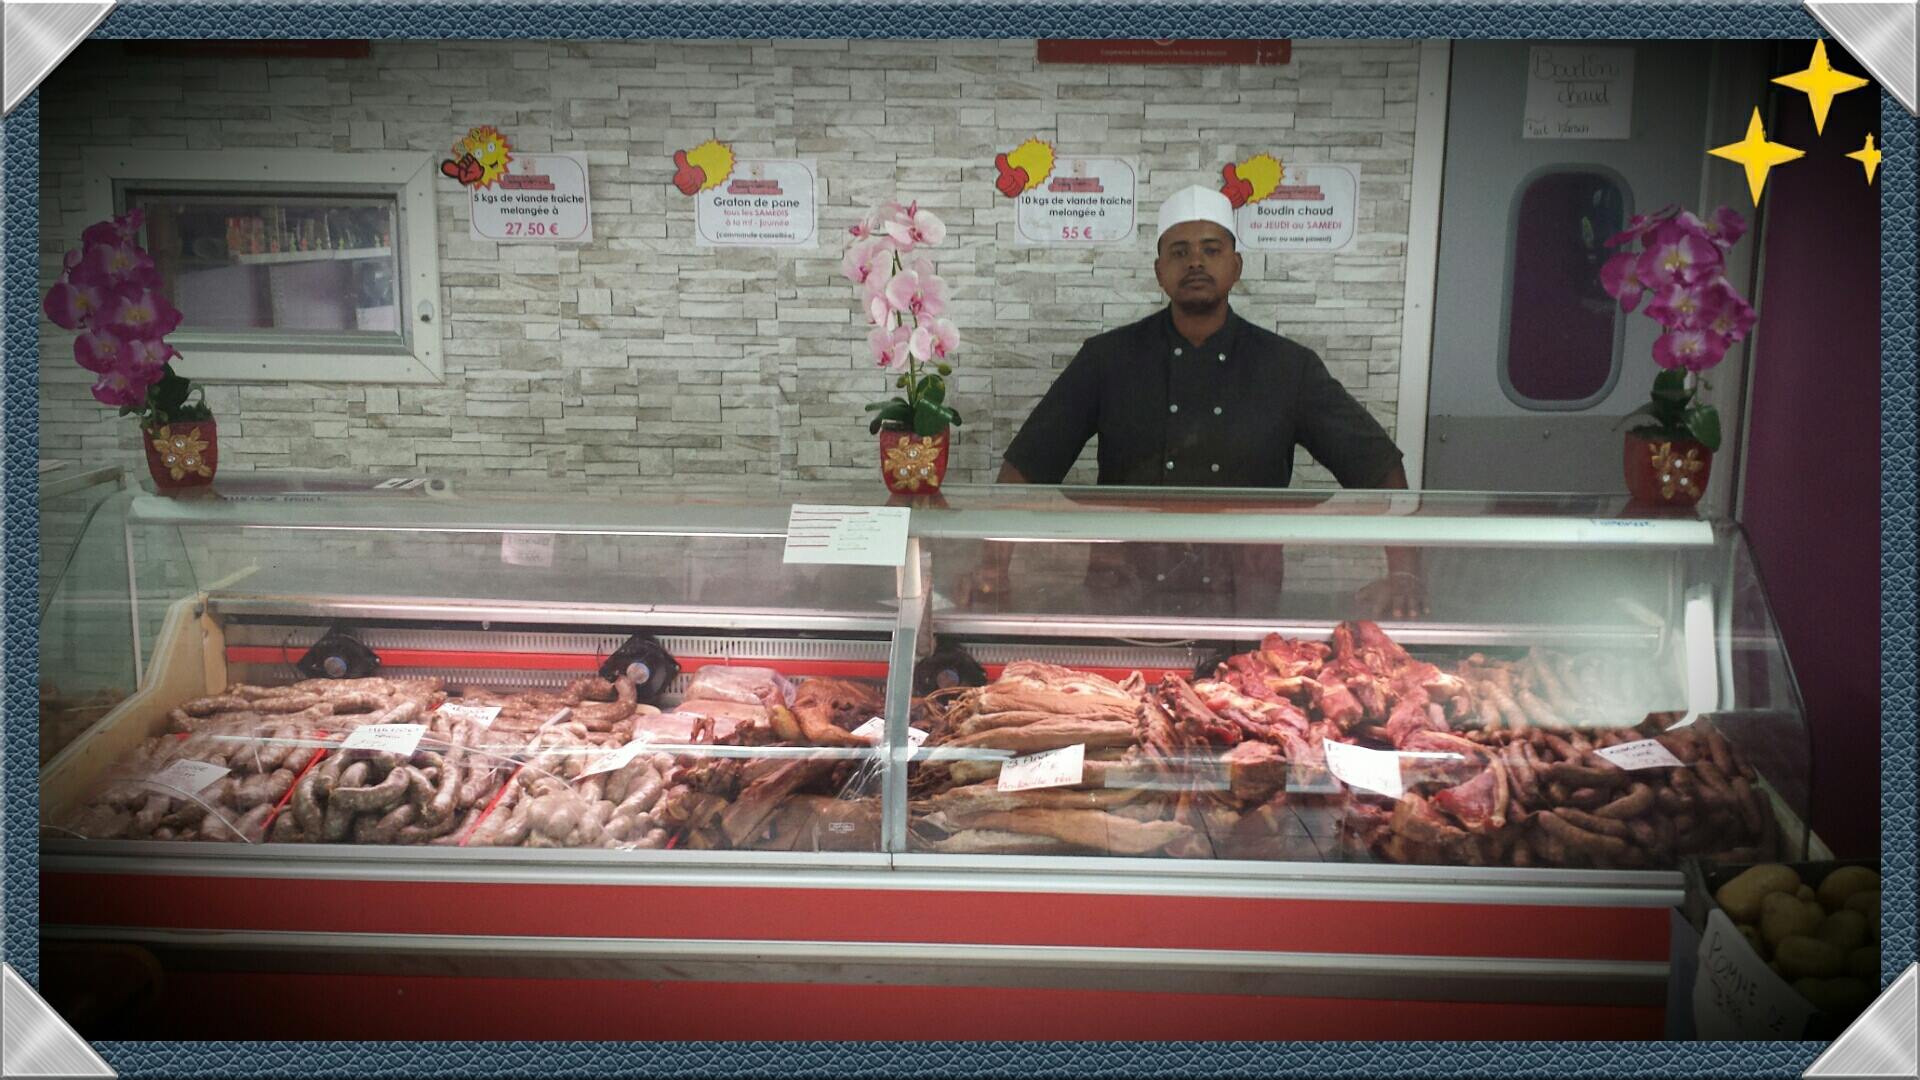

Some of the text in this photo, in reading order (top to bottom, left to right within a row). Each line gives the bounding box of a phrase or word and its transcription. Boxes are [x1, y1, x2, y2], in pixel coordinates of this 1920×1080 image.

[473, 193, 480, 202] 5
[481, 193, 498, 204] kgs
[500, 193, 513, 203] de
[515, 193, 549, 203] viande
[713, 197, 800, 210] Graton de pane
[1020, 196, 1031, 205] 10
[1033, 196, 1049, 206] kgs
[1051, 196, 1064, 205] de
[1066, 196, 1098, 205] viande
[552, 205, 559, 215] à
[723, 209, 789, 217] tous les SAMEDIS
[1098, 208, 1105, 217] à
[1257, 206, 1334, 215] Boudin chaud
[505, 222, 560, 236] 27,50 €
[1250, 221, 1342, 230] du JEUDI au SAMEDI
[1062, 226, 1093, 239] 55 €
